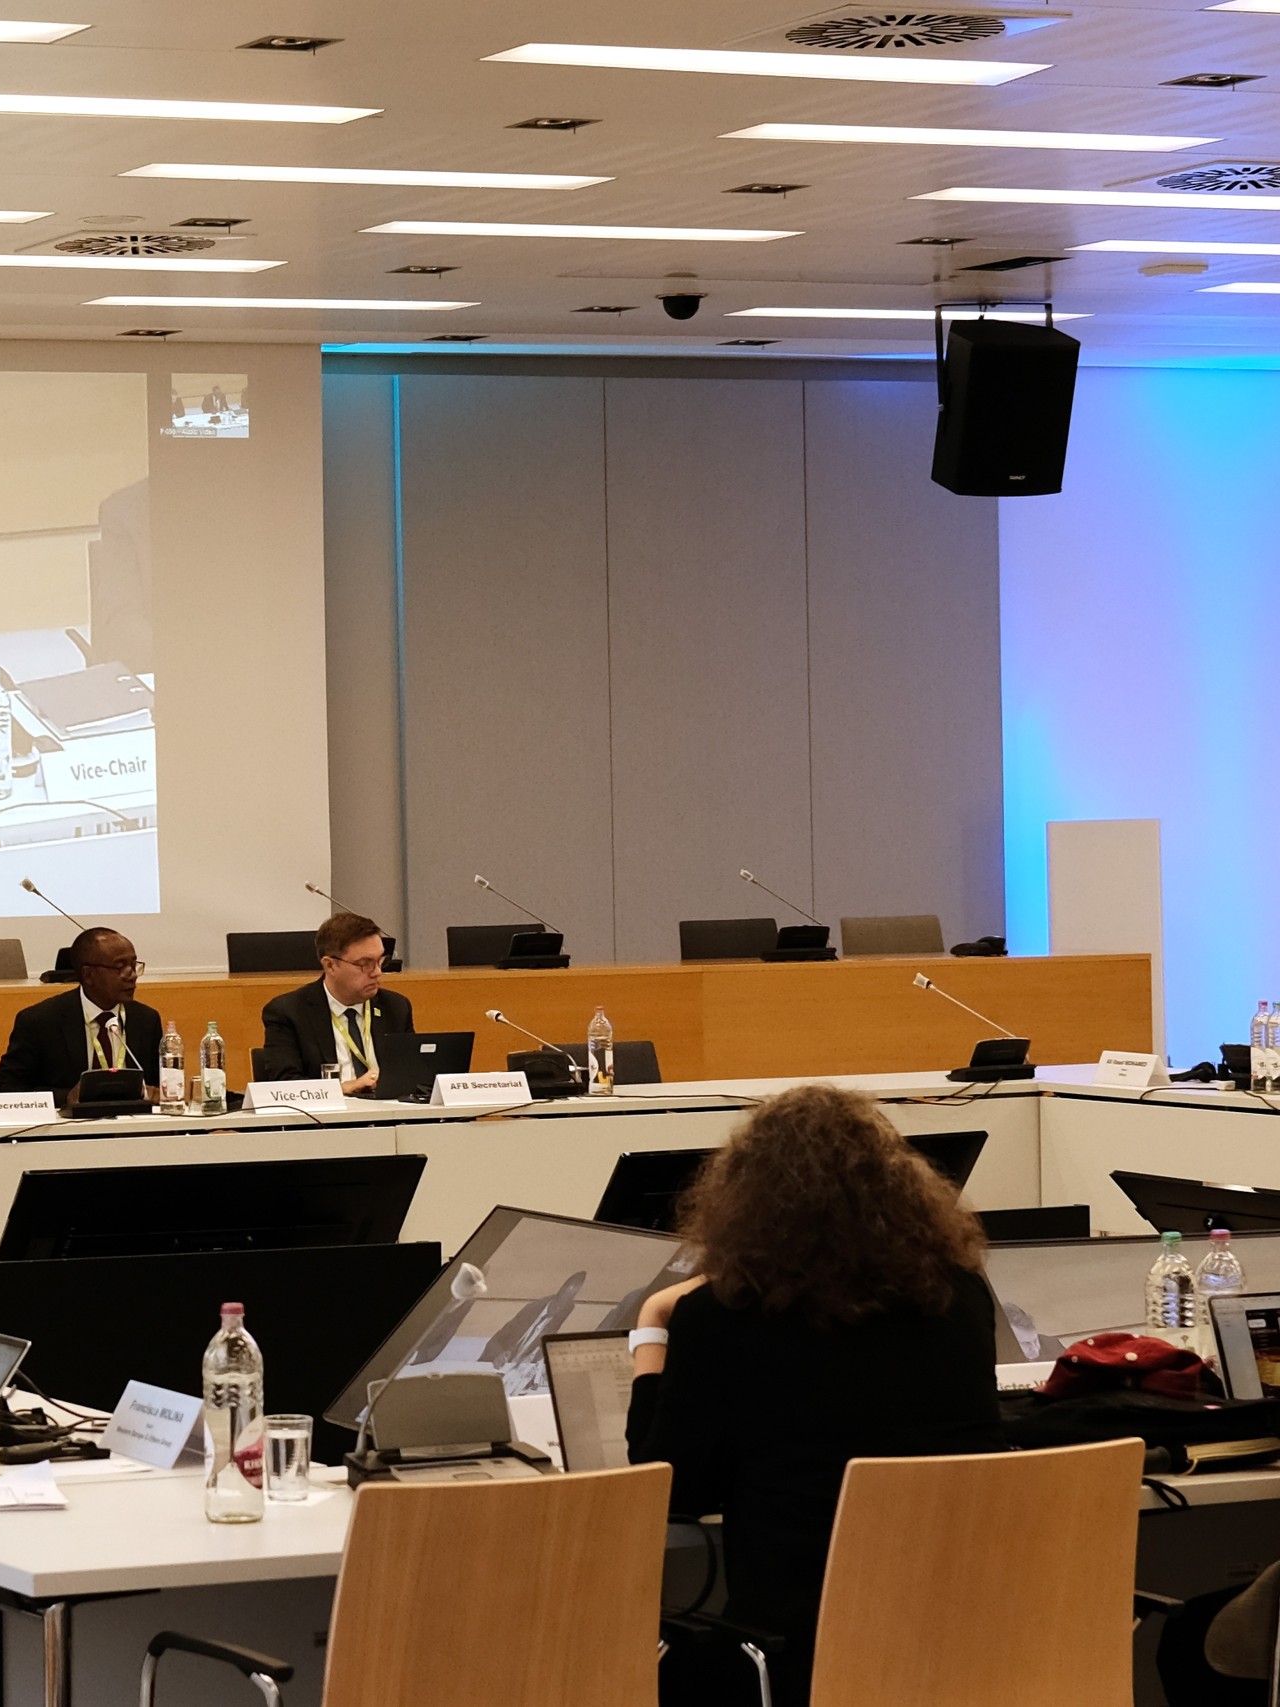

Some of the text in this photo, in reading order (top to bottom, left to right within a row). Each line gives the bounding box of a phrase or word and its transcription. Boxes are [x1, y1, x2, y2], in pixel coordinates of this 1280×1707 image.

[70, 756, 147, 781] Vice-Chair
[450, 1080, 523, 1090] AFB Secretariat
[270, 1088, 329, 1101] Vice-Chair
